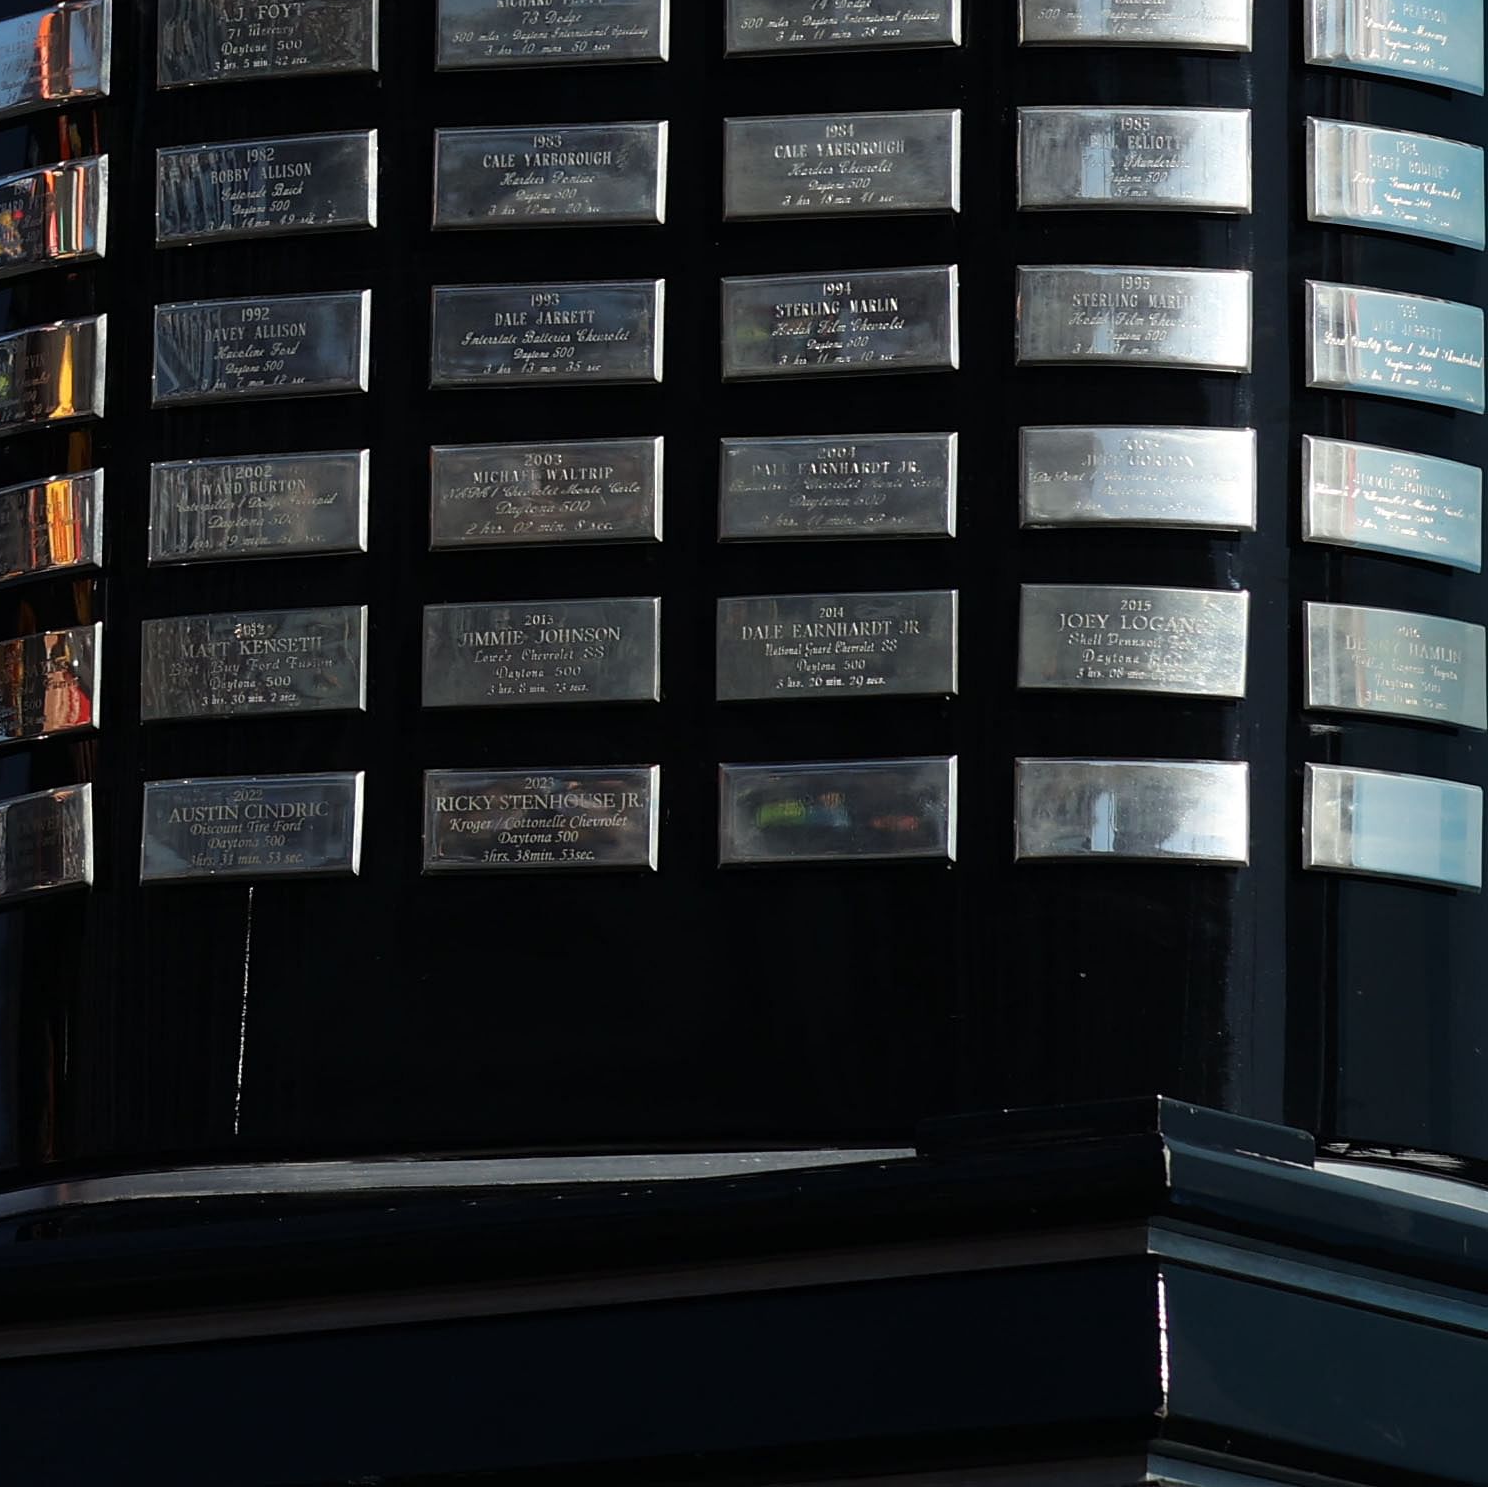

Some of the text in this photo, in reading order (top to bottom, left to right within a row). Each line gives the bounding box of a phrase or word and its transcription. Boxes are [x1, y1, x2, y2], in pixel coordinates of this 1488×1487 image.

[257, 3, 305, 20] FOYT
[825, 124, 855, 138] 1984
[1121, 118, 1150, 130] 1985
[533, 135, 562, 148] 1983
[774, 140, 905, 159] CALE YARBOROUGH
[246, 147, 275, 162] 1982
[483, 151, 612, 168] CALE YARBOROUGH
[211, 162, 312, 184] BOBBY ALLISON
[822, 282, 852, 295] 1994
[1121, 276, 1150, 290] 1995
[531, 293, 560, 307] 1993
[775, 298, 898, 318] STERLING MARLIN
[241, 307, 270, 322] 1992
[495, 310, 595, 326] DALE JARRETT
[204, 322, 306, 342] DAVEY ALLISON
[525, 453, 563, 466] 2003
[235, 465, 273, 479] 2002
[546, 467, 614, 480] WALTRIP
[250, 478, 306, 494] BURTON
[819, 607, 844, 618] 2014
[1121, 600, 1152, 611] 2015
[458, 627, 621, 647] JIMMIE JOHNSON
[742, 625, 784, 640] DALE
[792, 621, 892, 638] EARNHARDT
[181, 636, 322, 659] MATT KENSETH
[1409, 642, 1462, 663] HAMLIN
[524, 777, 555, 789] 2023
[436, 793, 644, 812] RICKY STENHOUSE JR.
[168, 801, 328, 823] AUSTIN CINDRIC
[190, 820, 241, 835] Discount
[273, 818, 304, 831] Ford
[208, 837, 259, 850] Daytona
[498, 830, 579, 846] Daytona 500
